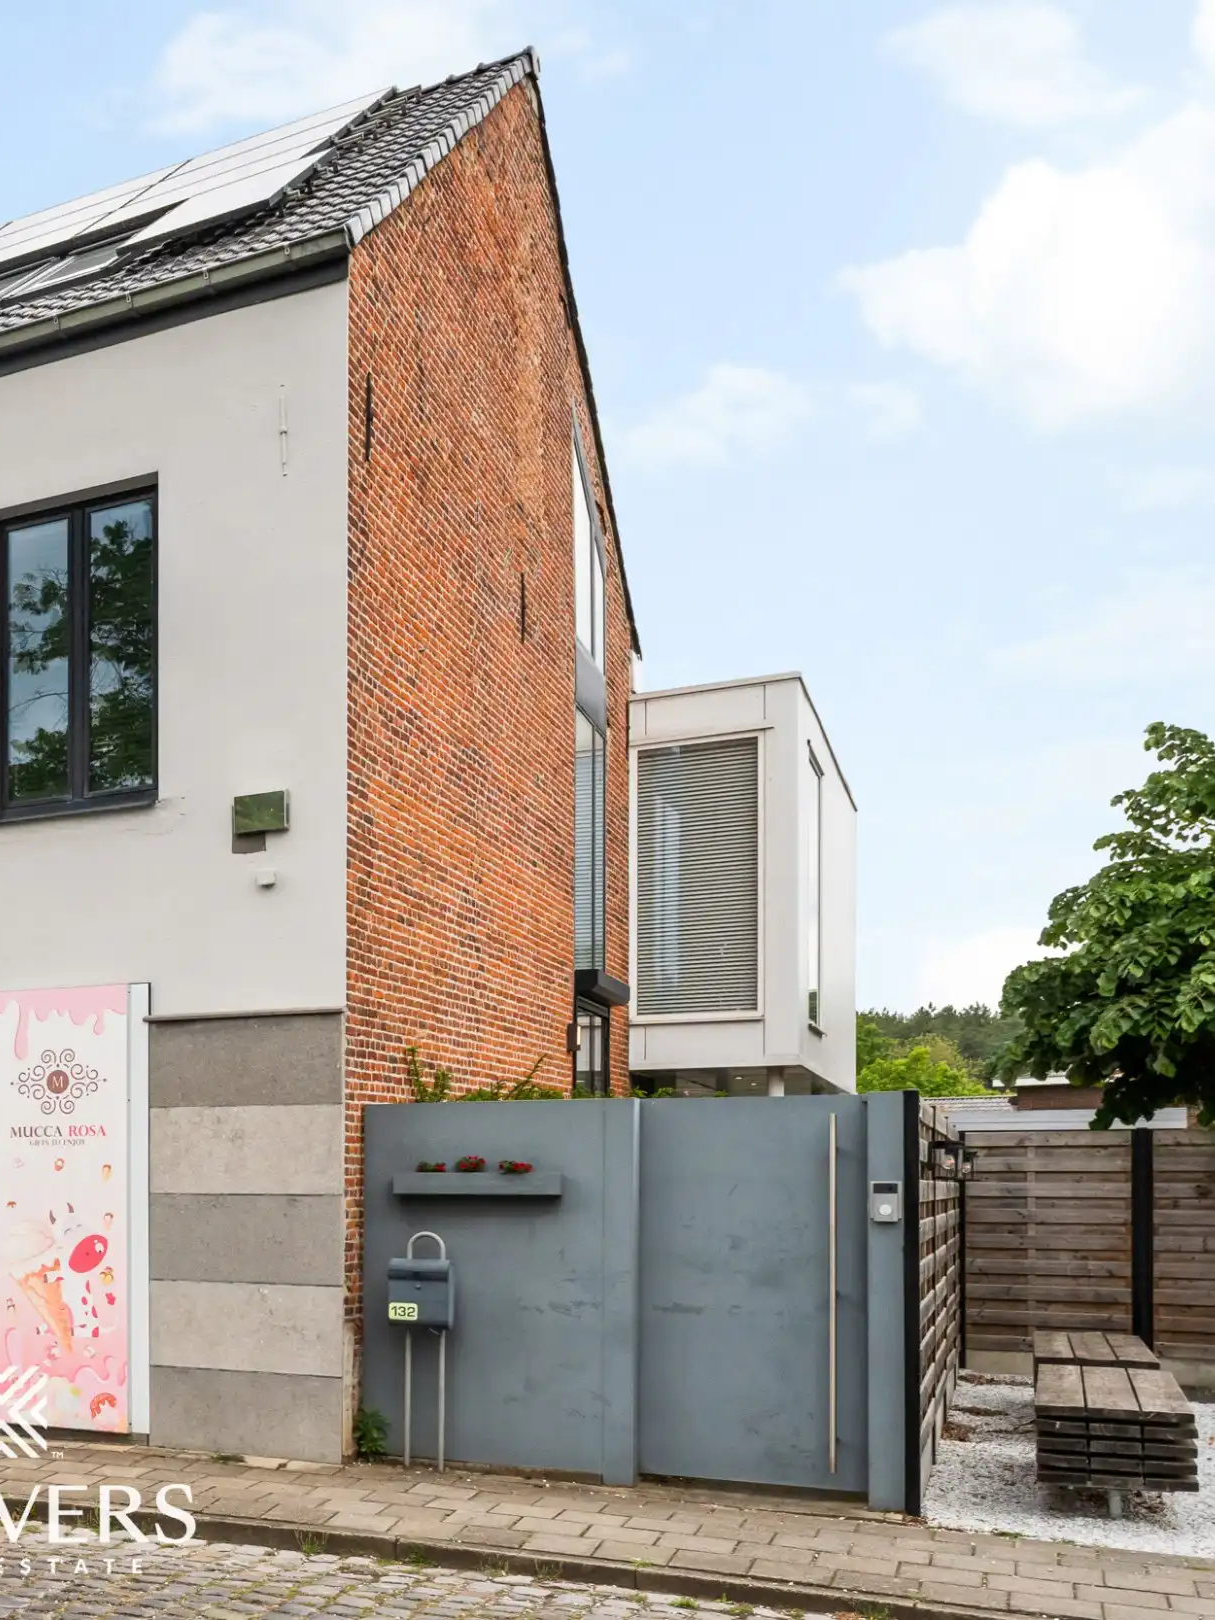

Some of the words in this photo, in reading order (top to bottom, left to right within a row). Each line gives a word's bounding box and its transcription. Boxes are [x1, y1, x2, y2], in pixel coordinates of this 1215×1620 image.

[52, 1076, 63, 1088] M
[10, 1125, 63, 1138] MUCCA
[68, 1124, 106, 1137] ROSA
[391, 1306, 416, 1317] 132
